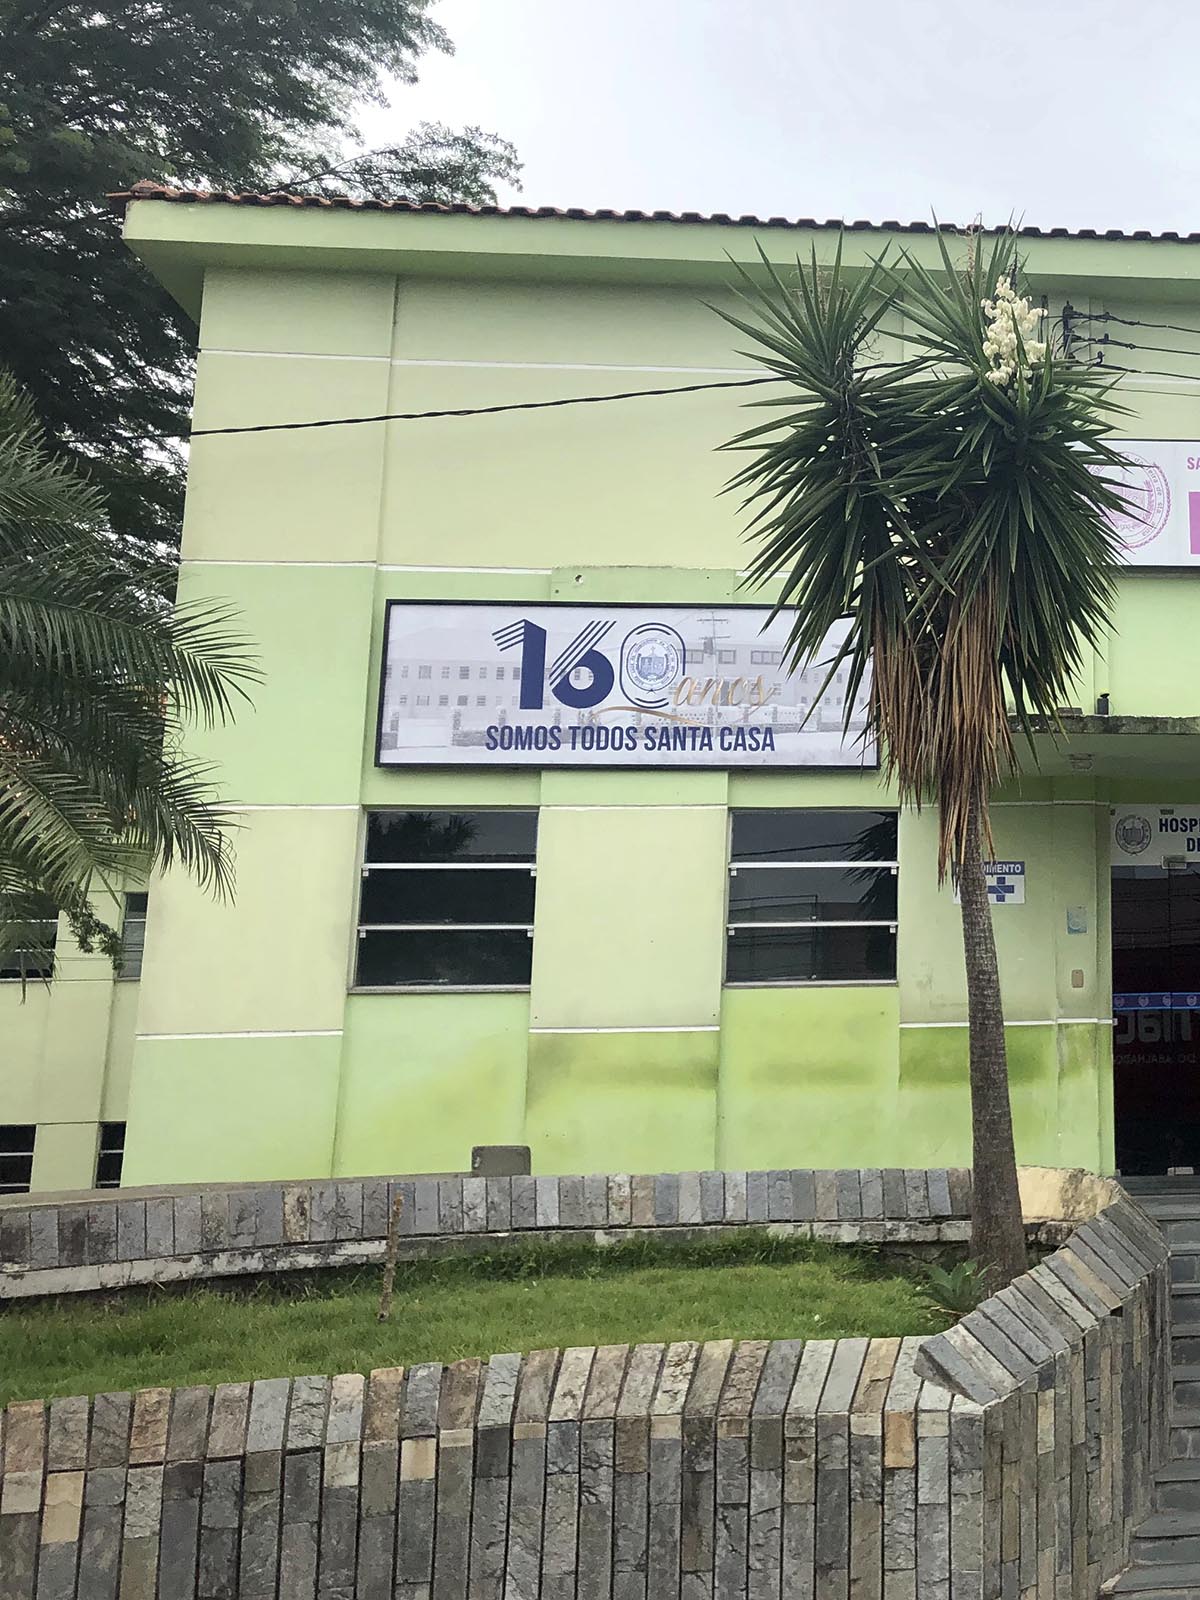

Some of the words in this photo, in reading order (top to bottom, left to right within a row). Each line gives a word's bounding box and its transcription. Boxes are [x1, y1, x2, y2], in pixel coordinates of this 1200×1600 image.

[492, 619, 686, 709] 160
[673, 675, 779, 707] anos
[485, 725, 562, 751] SOMOS
[568, 725, 637, 751] TODOS
[644, 726, 713, 751] SANTA
[719, 726, 775, 751] CASA
